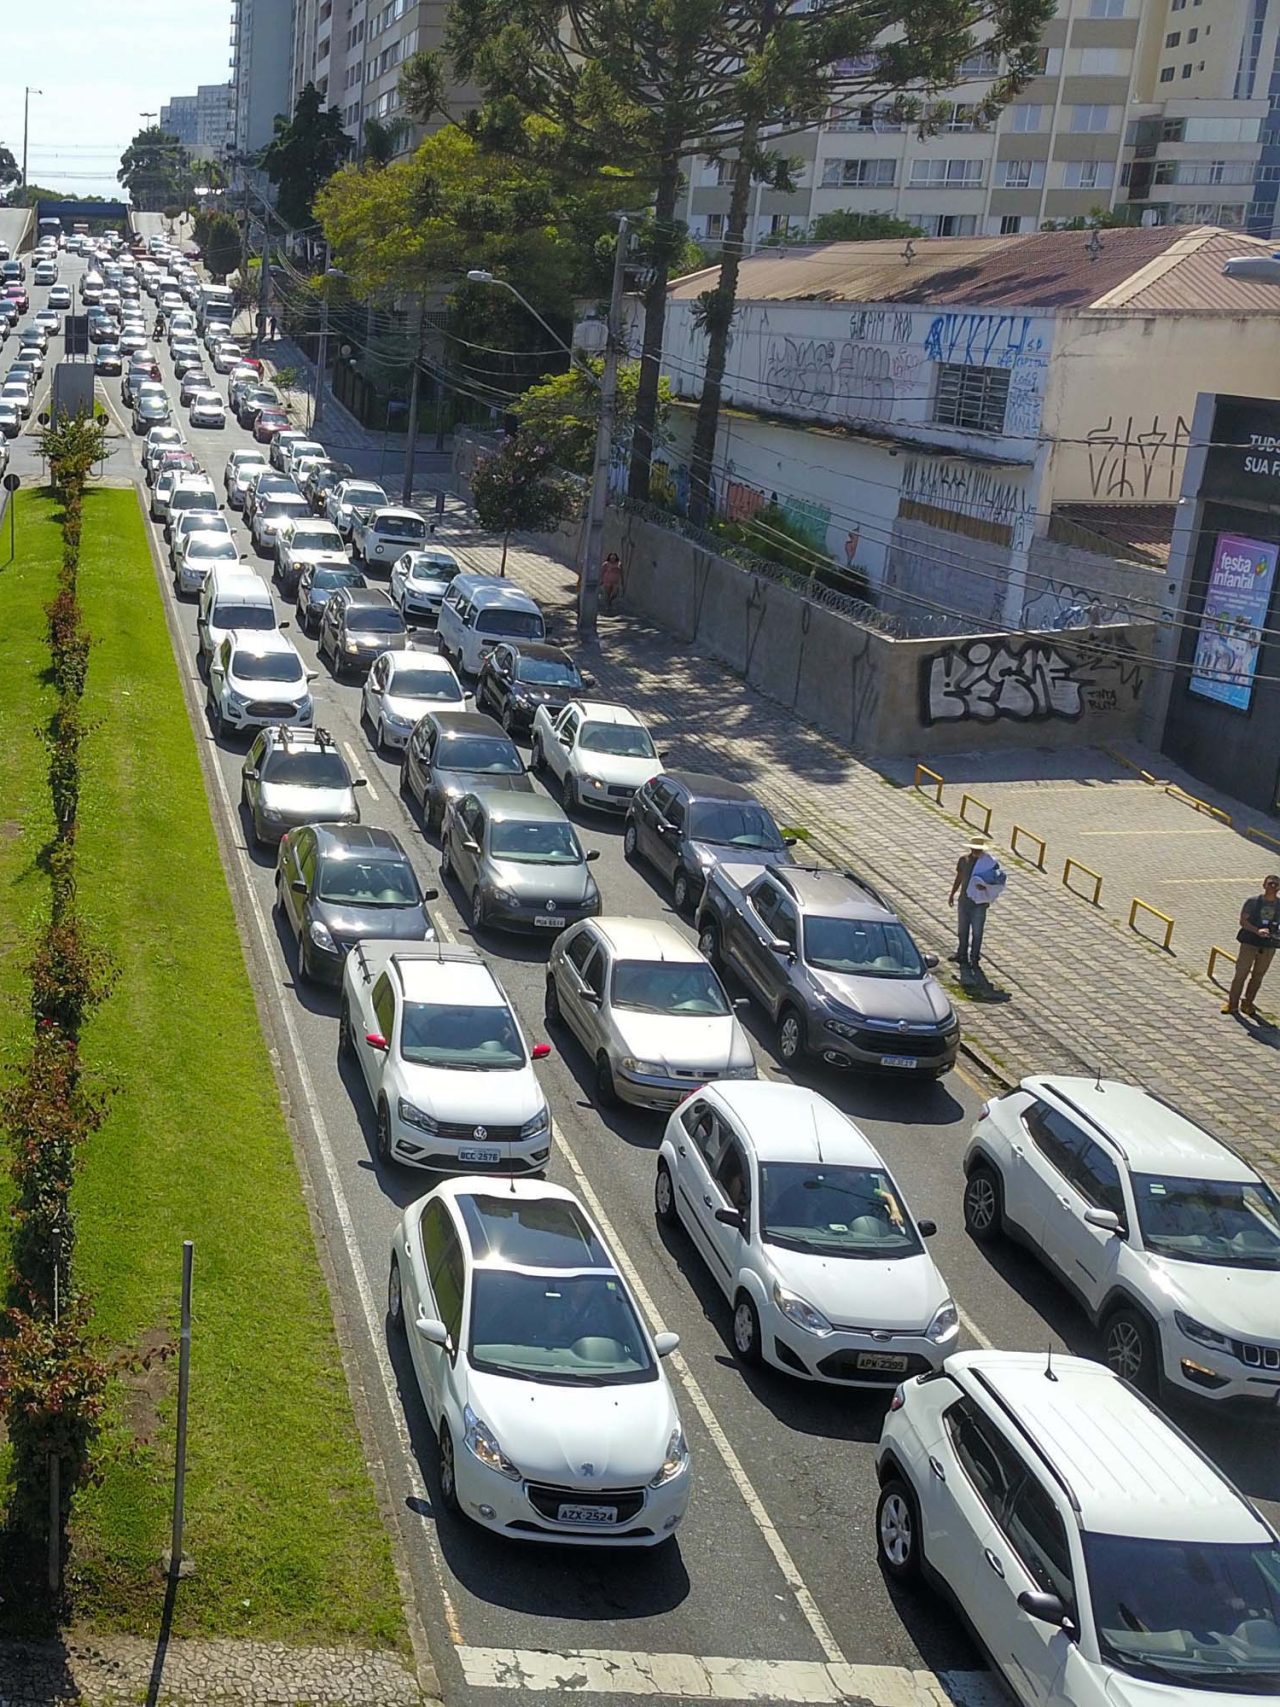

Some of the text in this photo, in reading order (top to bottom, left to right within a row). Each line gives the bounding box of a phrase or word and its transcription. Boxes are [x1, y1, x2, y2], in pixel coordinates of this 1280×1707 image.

[1244, 456, 1269, 475] SUA
[1220, 552, 1252, 573] festa
[1212, 568, 1255, 590] infantil
